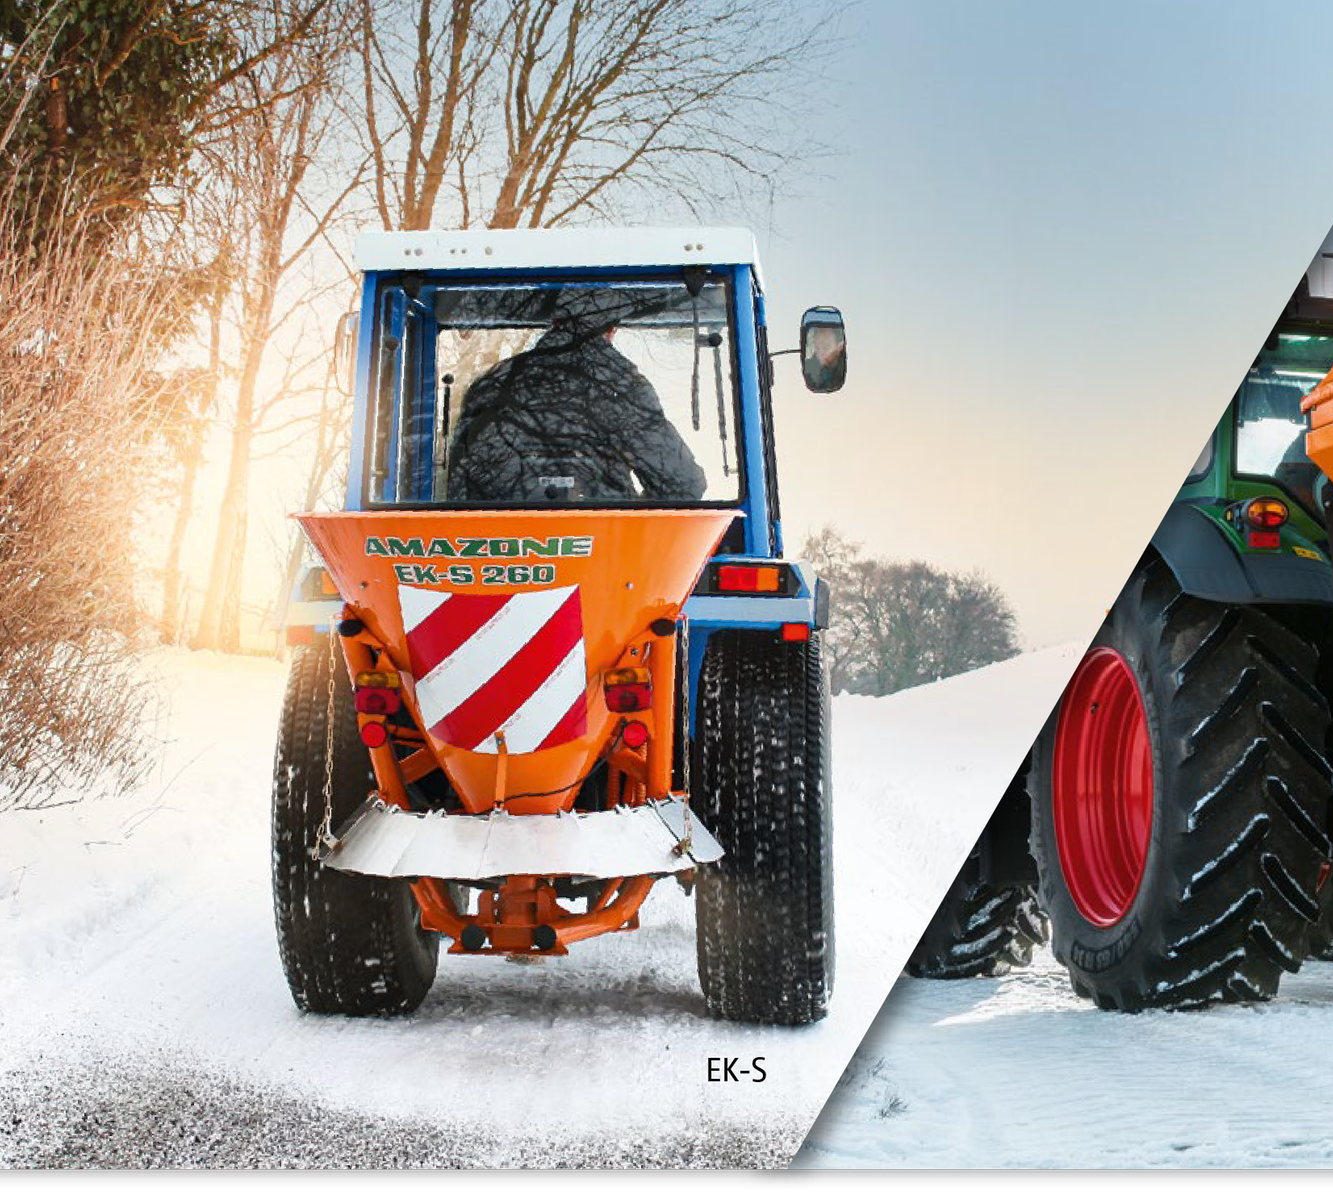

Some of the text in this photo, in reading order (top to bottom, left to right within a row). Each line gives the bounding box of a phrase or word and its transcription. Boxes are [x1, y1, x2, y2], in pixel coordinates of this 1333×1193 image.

[365, 536, 594, 558] AMAZONE
[393, 564, 557, 586] EK-S 260
